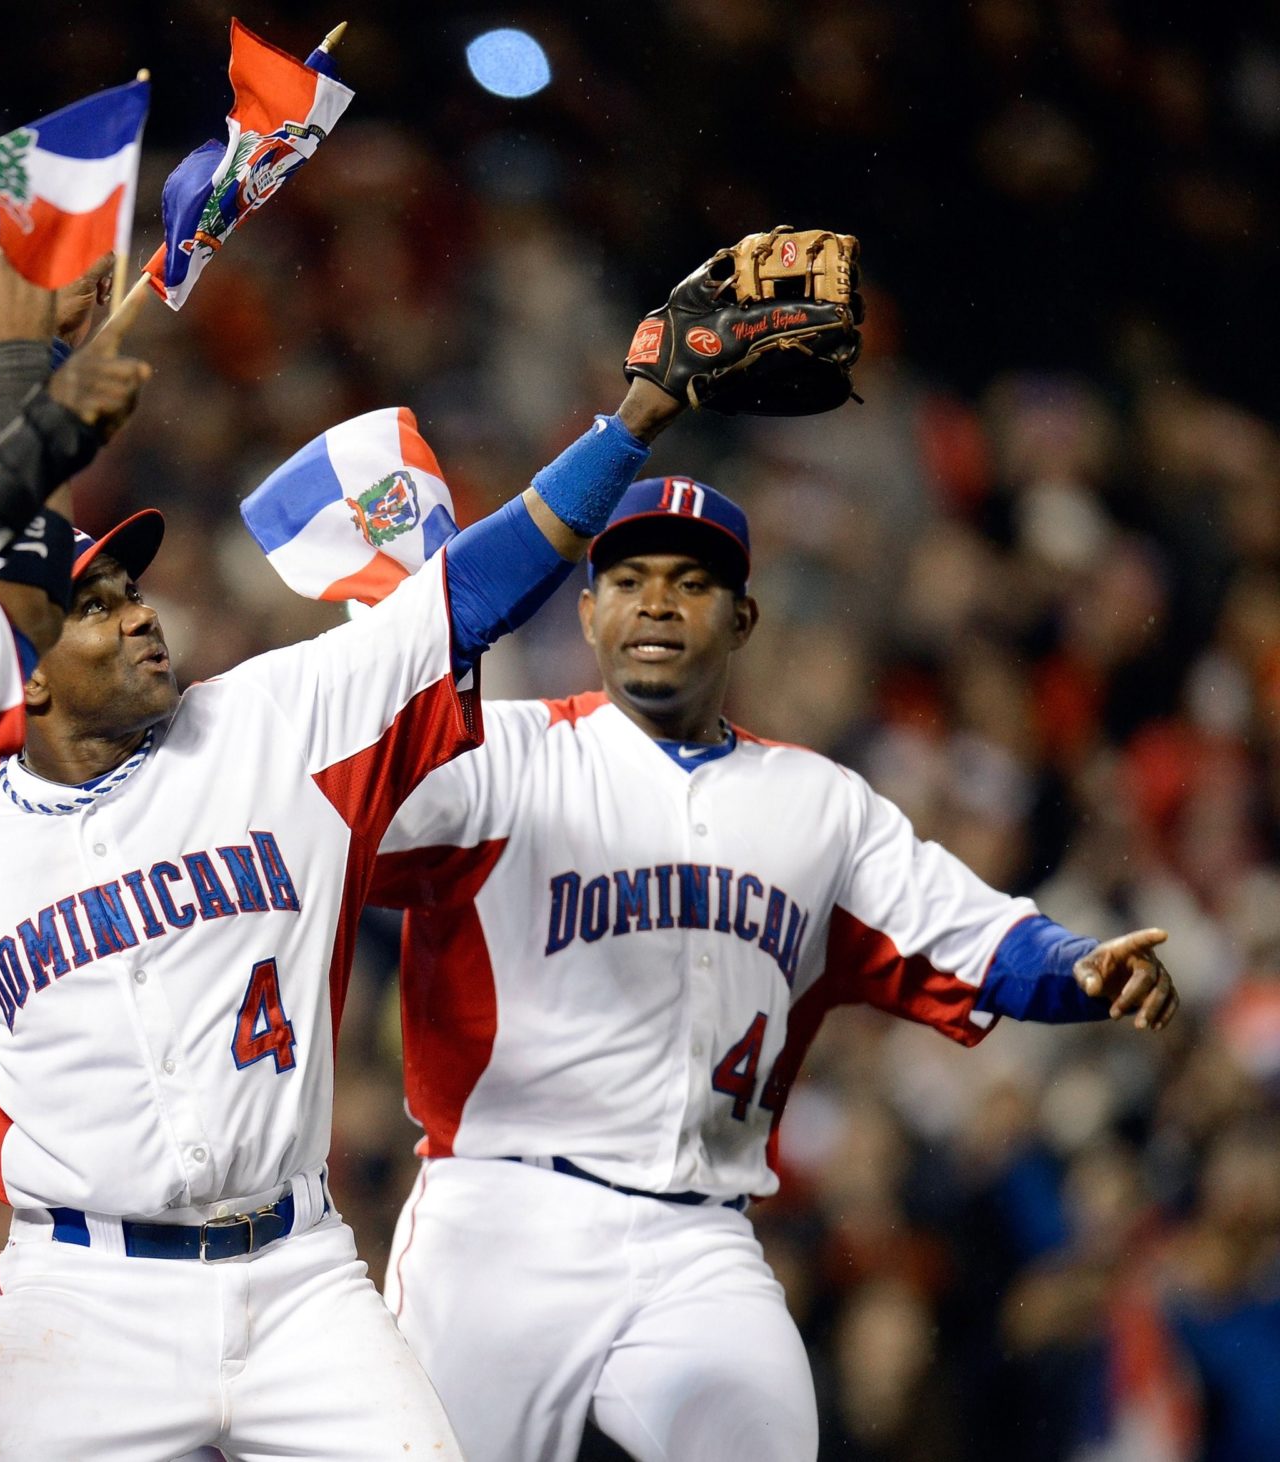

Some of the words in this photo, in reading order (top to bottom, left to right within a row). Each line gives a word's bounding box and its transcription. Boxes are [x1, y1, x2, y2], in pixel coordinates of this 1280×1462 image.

[732, 314, 768, 340] Miguel
[772, 306, 808, 329] Tejada
[231, 956, 297, 1075] 4
